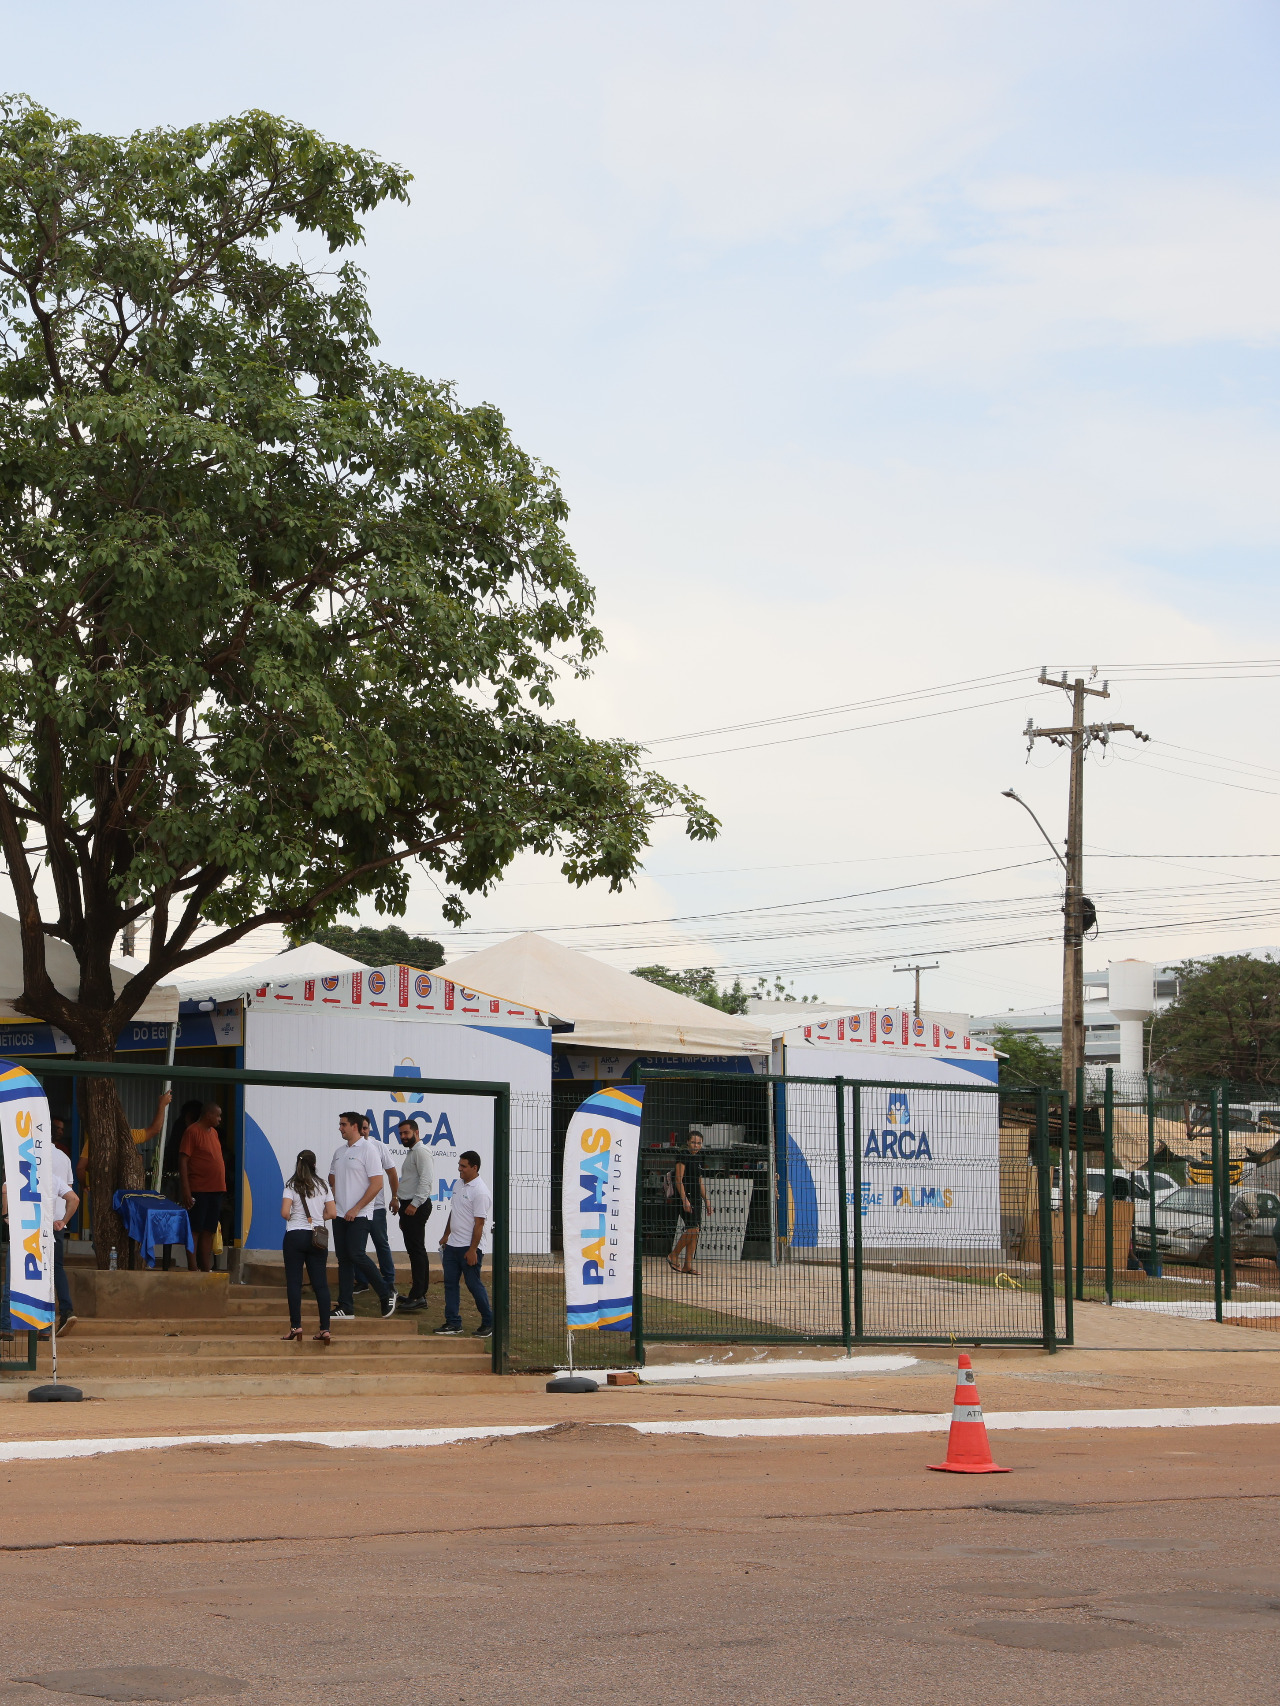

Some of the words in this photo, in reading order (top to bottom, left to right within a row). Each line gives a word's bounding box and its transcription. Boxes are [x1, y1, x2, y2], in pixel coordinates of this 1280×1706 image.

[133, 1027, 148, 1040] DO
[646, 1056, 679, 1064] STYLE
[681, 1055, 728, 1064] IMPORTS
[864, 1129, 933, 1160] ARCA
[16, 1110, 43, 1281] PALMAS
[580, 1127, 612, 1286] PALMAS
[608, 1139, 623, 1277] PREFEITURA
[892, 1186, 953, 1208] PALMAS
